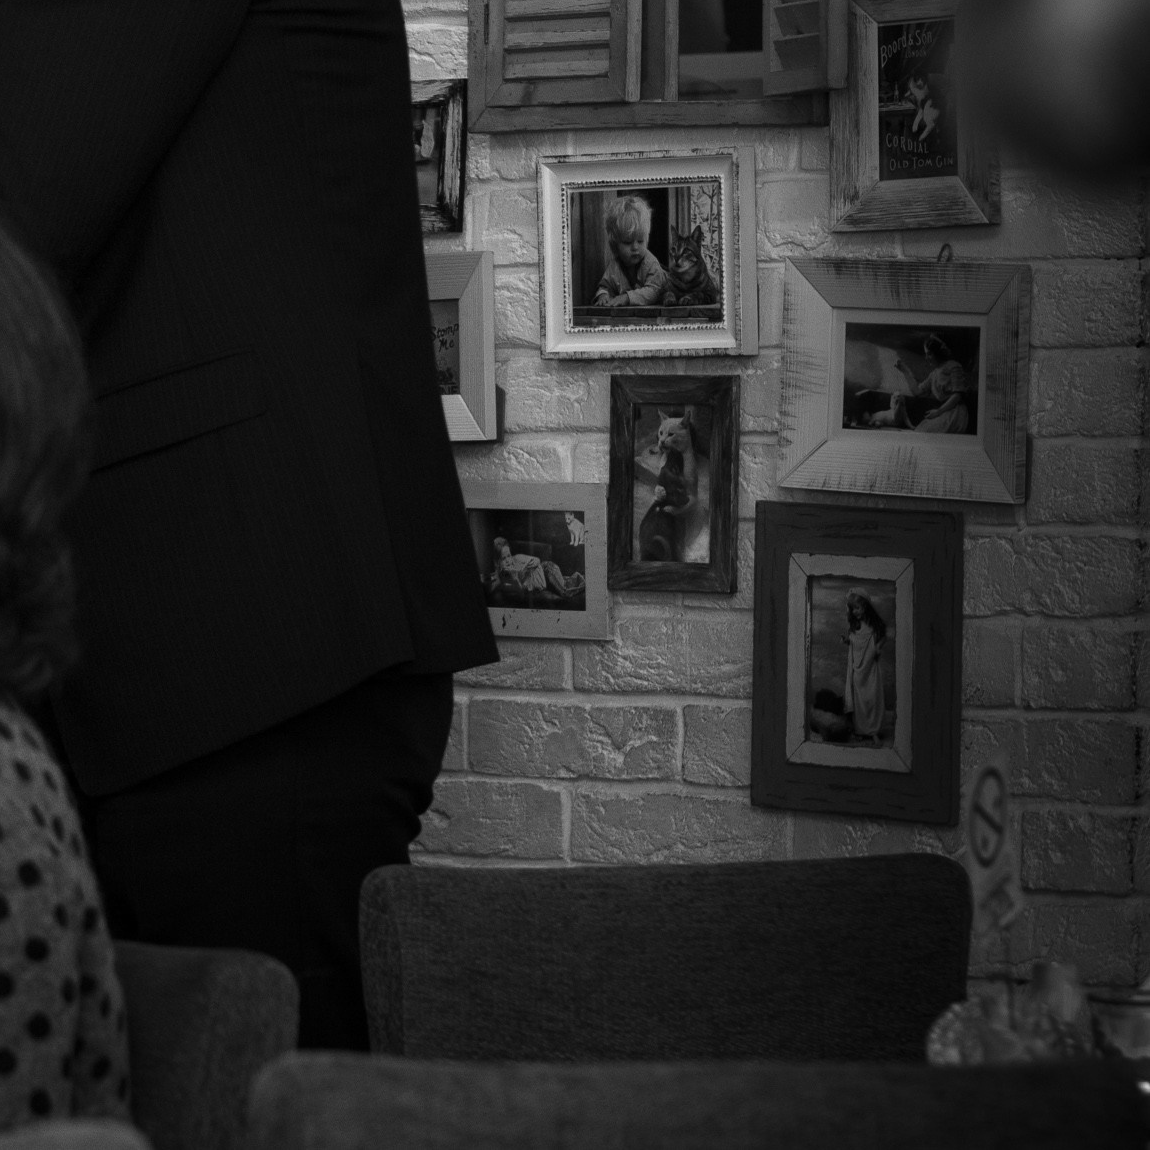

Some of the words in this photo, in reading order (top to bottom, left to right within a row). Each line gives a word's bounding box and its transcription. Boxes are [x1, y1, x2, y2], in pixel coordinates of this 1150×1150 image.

[880, 31, 907, 69] Boord
[915, 29, 932, 46] Son
[886, 132, 929, 154] CORDIAL
